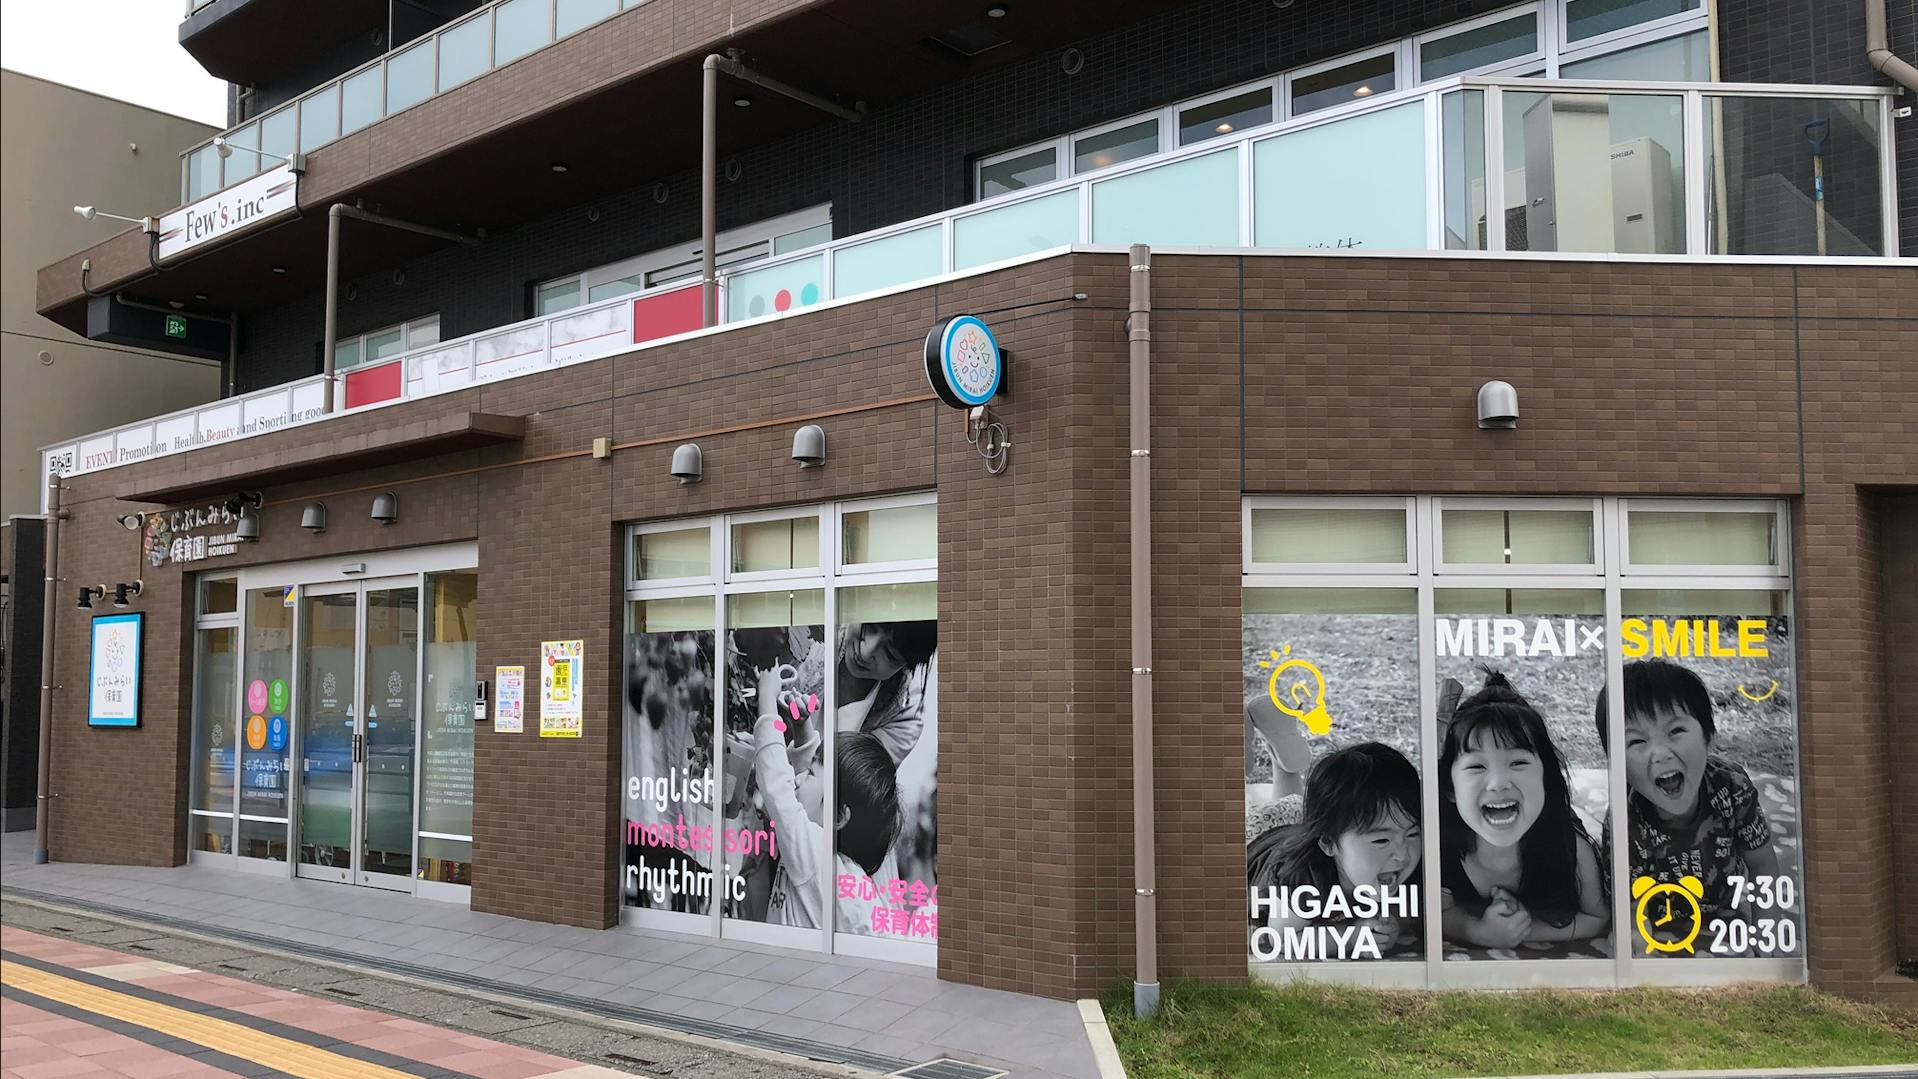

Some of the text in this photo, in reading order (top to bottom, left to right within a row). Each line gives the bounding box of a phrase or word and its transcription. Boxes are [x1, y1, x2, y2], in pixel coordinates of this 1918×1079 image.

[185, 198, 265, 243] Few's.inc
[120, 440, 168, 462] Promotion
[169, 535, 206, 563] 保育園
[1620, 618, 1769, 658] SMILE
[628, 766, 715, 813] english
[627, 813, 776, 860] montessori
[626, 855, 746, 904] rhythmic
[1727, 875, 1794, 910] 7:30
[1250, 884, 1418, 919] HIGASHI
[1250, 926, 1382, 961] OMIYA
[1709, 918, 1796, 953] 20:30
